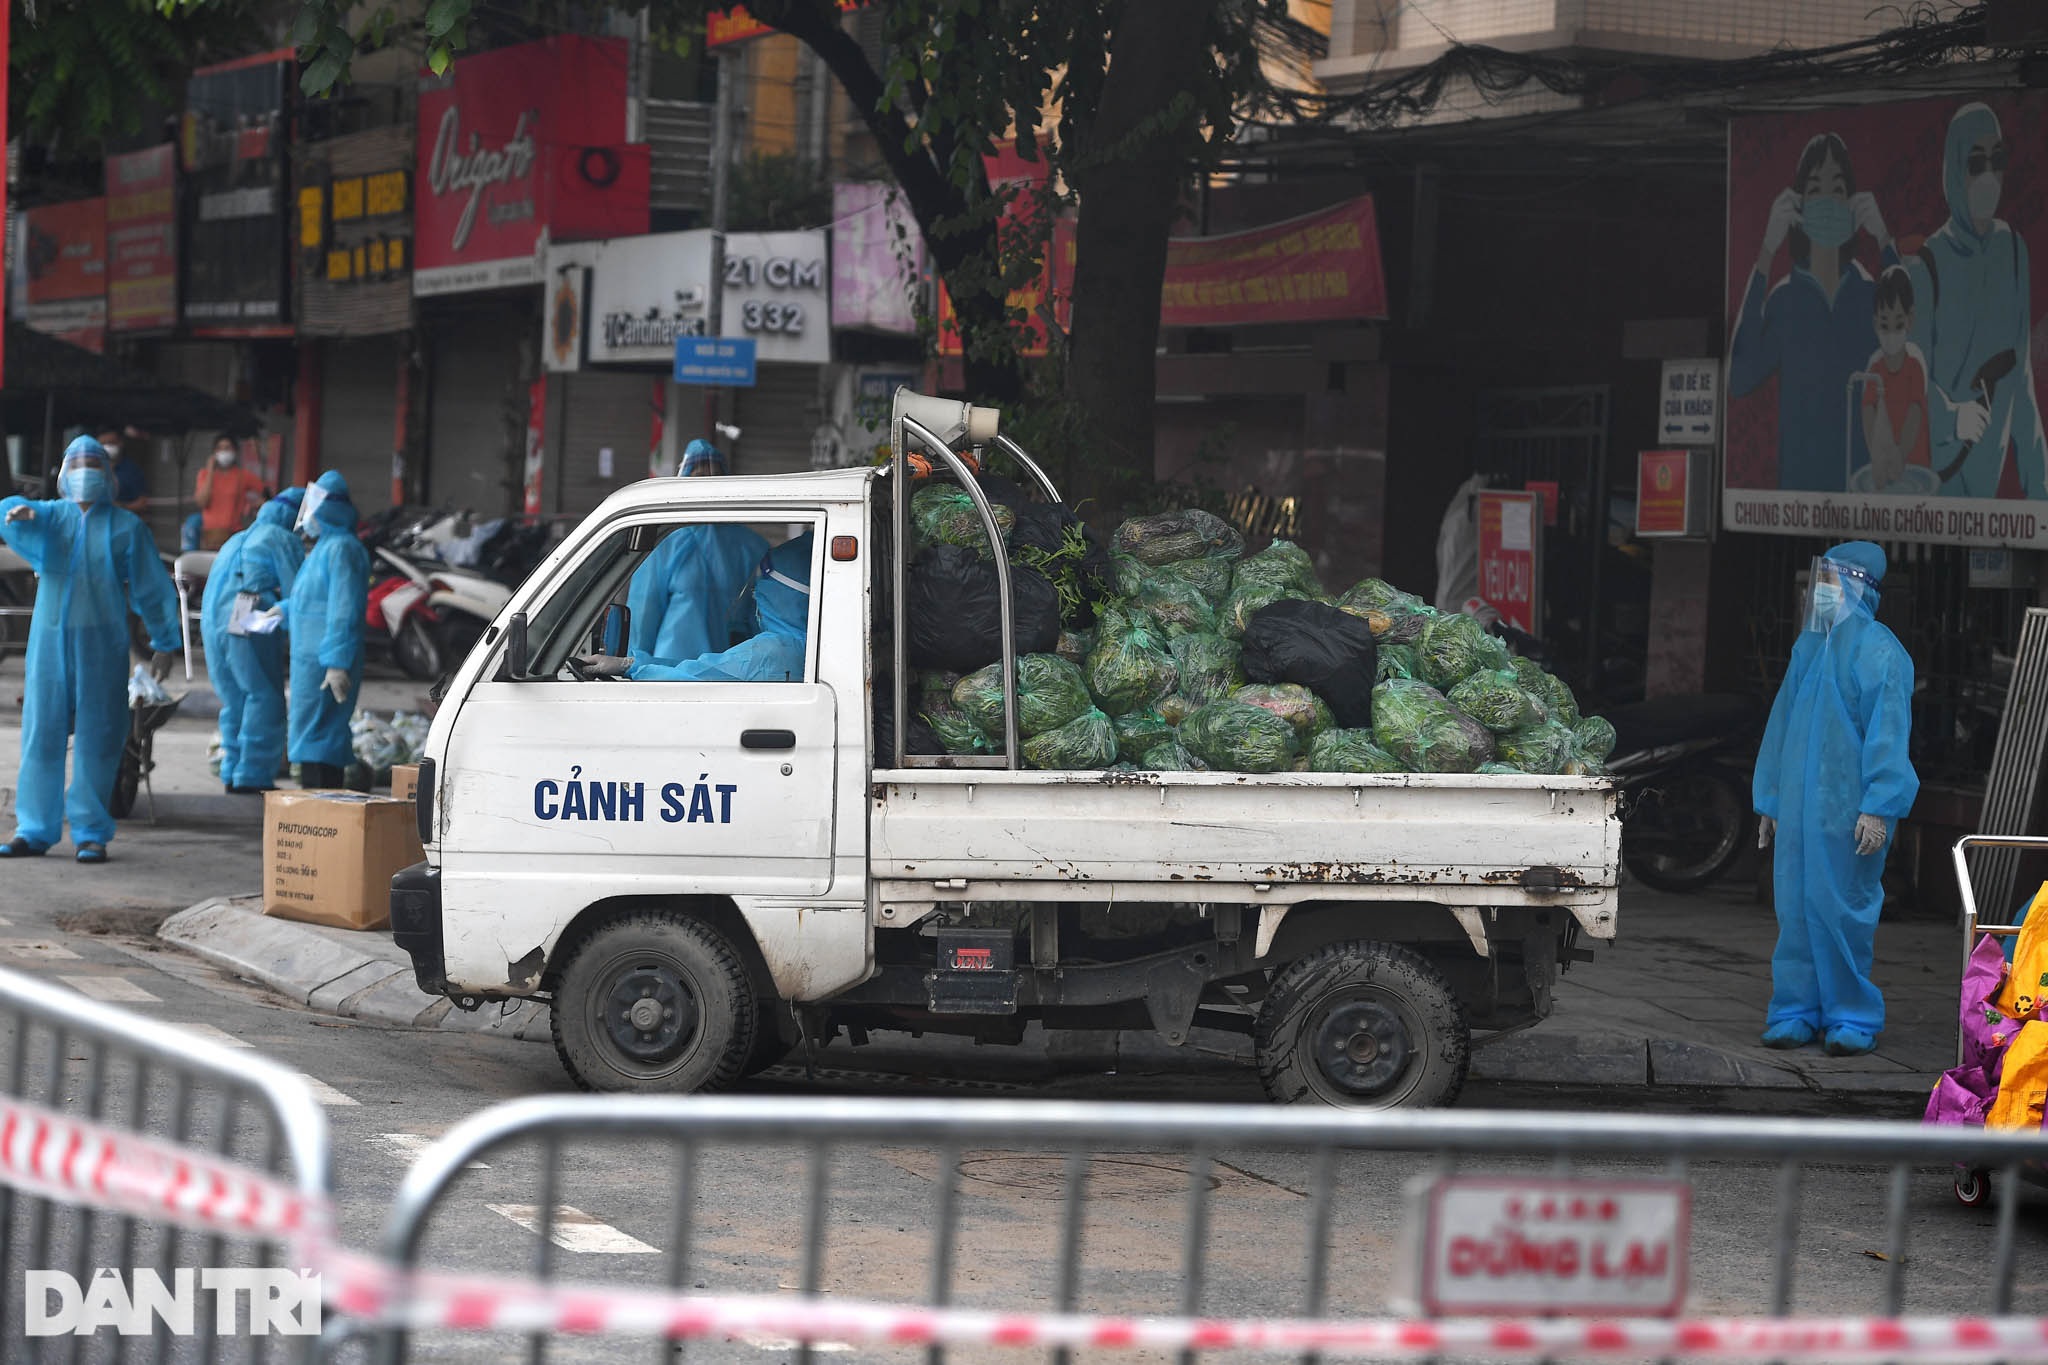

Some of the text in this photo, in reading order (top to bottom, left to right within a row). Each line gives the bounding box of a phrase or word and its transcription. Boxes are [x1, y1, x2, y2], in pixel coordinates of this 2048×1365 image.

[724, 255, 823, 291] 21 CM
[742, 301, 805, 337] 332
[1735, 501, 1780, 527] CHUNG
[1783, 500, 1809, 529] SỨC
[1812, 498, 1849, 530] ĐỒNG
[1854, 502, 1890, 532] LÒNG
[1894, 502, 1943, 535] CHỐNG
[1948, 510, 1984, 541] DỊCH
[1988, 513, 2035, 539] COVID
[534, 765, 738, 824] CẢNH SÁT
